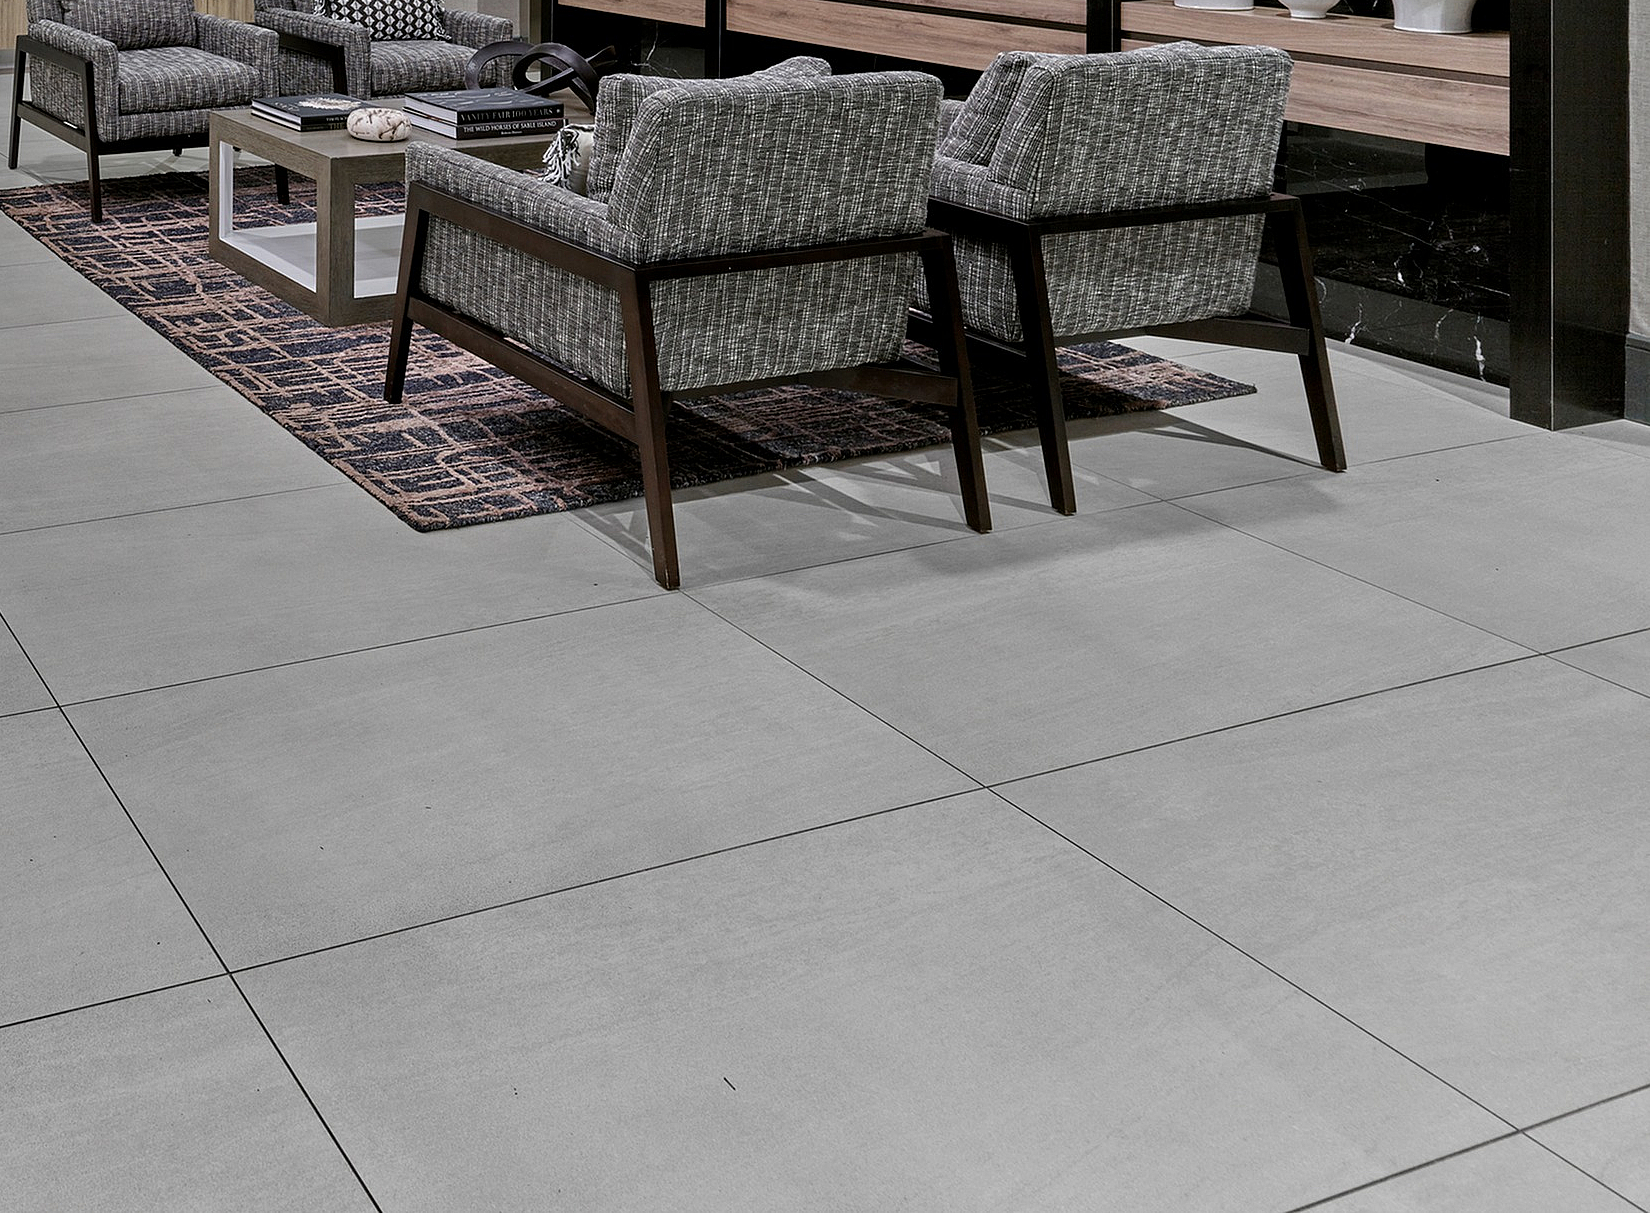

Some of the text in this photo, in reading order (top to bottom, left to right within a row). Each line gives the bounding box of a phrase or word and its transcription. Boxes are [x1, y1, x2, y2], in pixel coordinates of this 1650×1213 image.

[460, 107, 553, 121] VANITY FAIR 100 YEARS
[463, 125, 474, 133] THE
[491, 123, 511, 131] HORSES
[520, 121, 536, 129] SABLE
[536, 120, 557, 128] ISLAND
